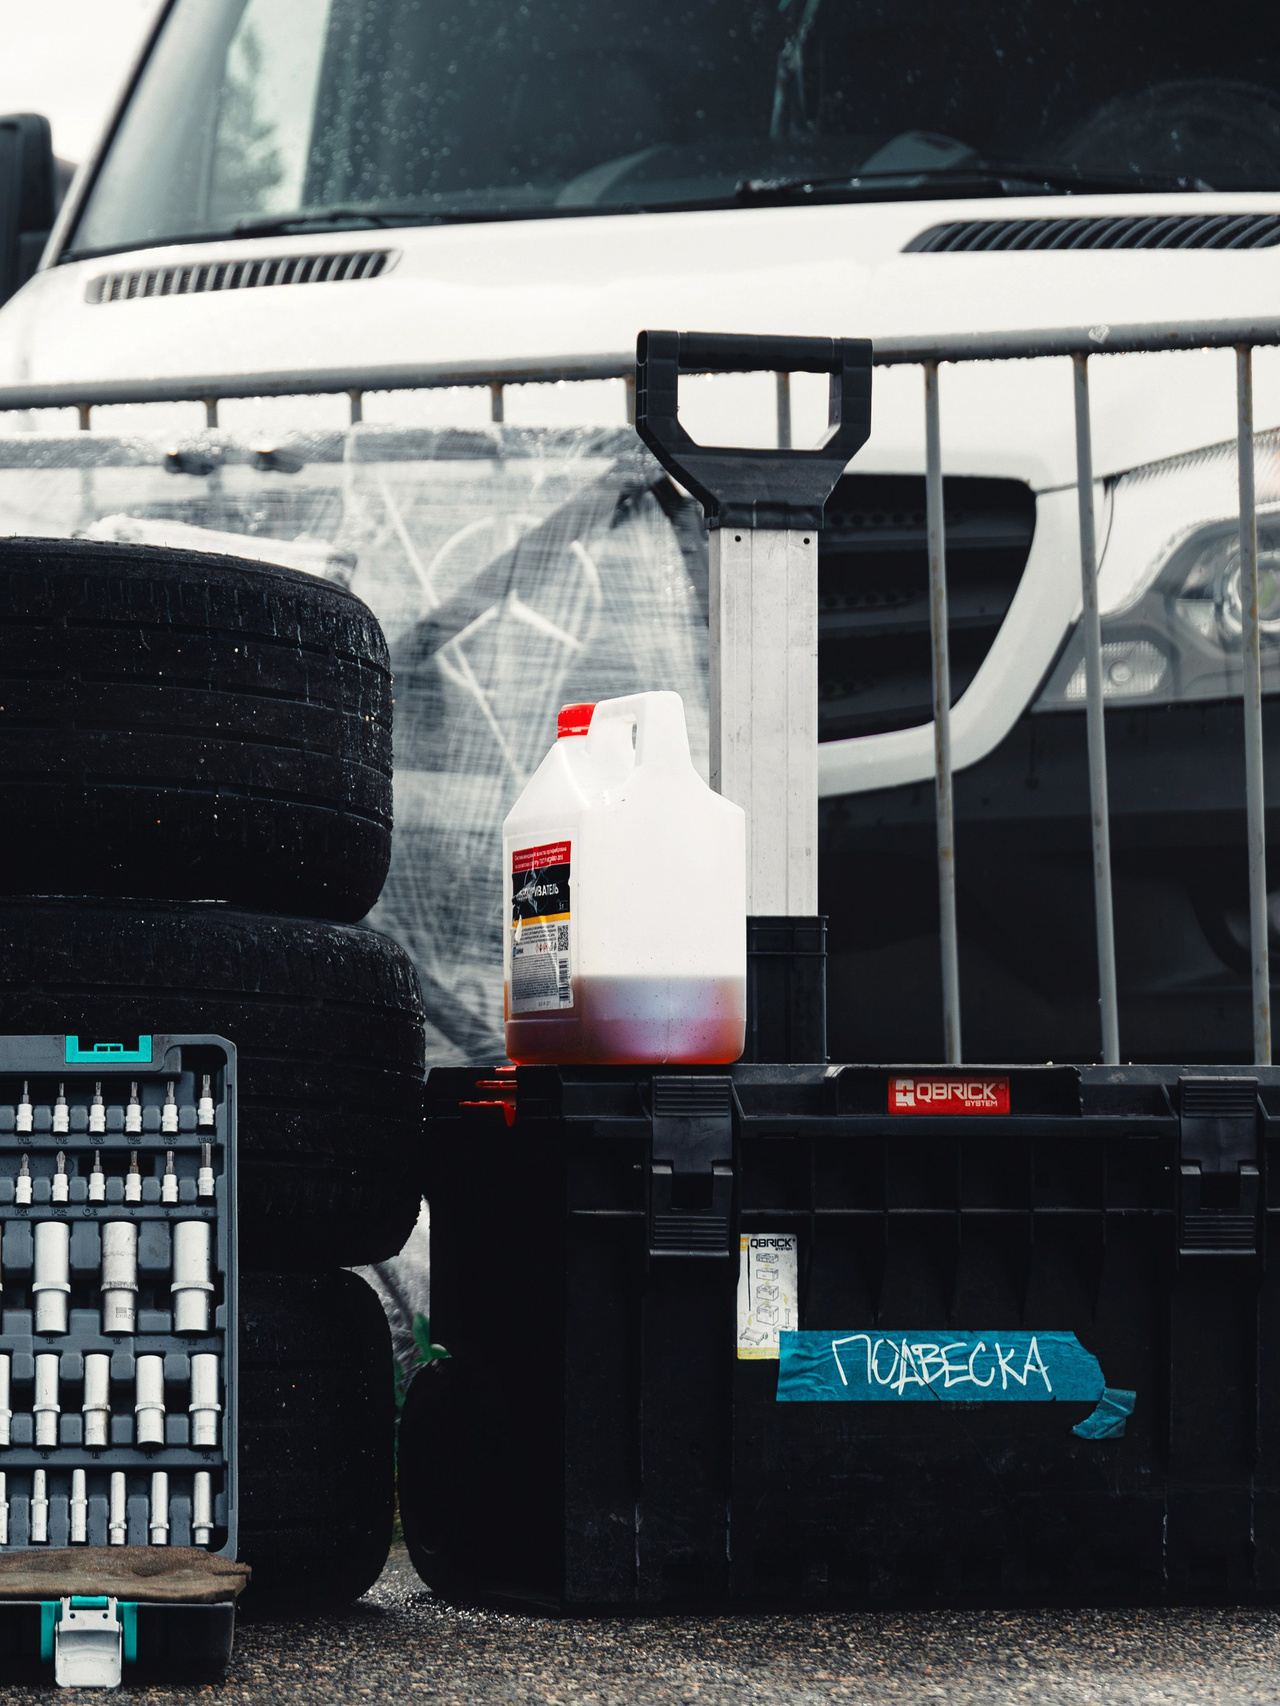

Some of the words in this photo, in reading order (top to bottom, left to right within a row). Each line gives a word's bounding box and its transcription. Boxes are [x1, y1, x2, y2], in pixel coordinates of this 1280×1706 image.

[917, 1083, 997, 1102] QBRICK
[750, 1238, 792, 1249] QBRICK
[832, 1334, 1052, 1395] ПОДВЕСКА
